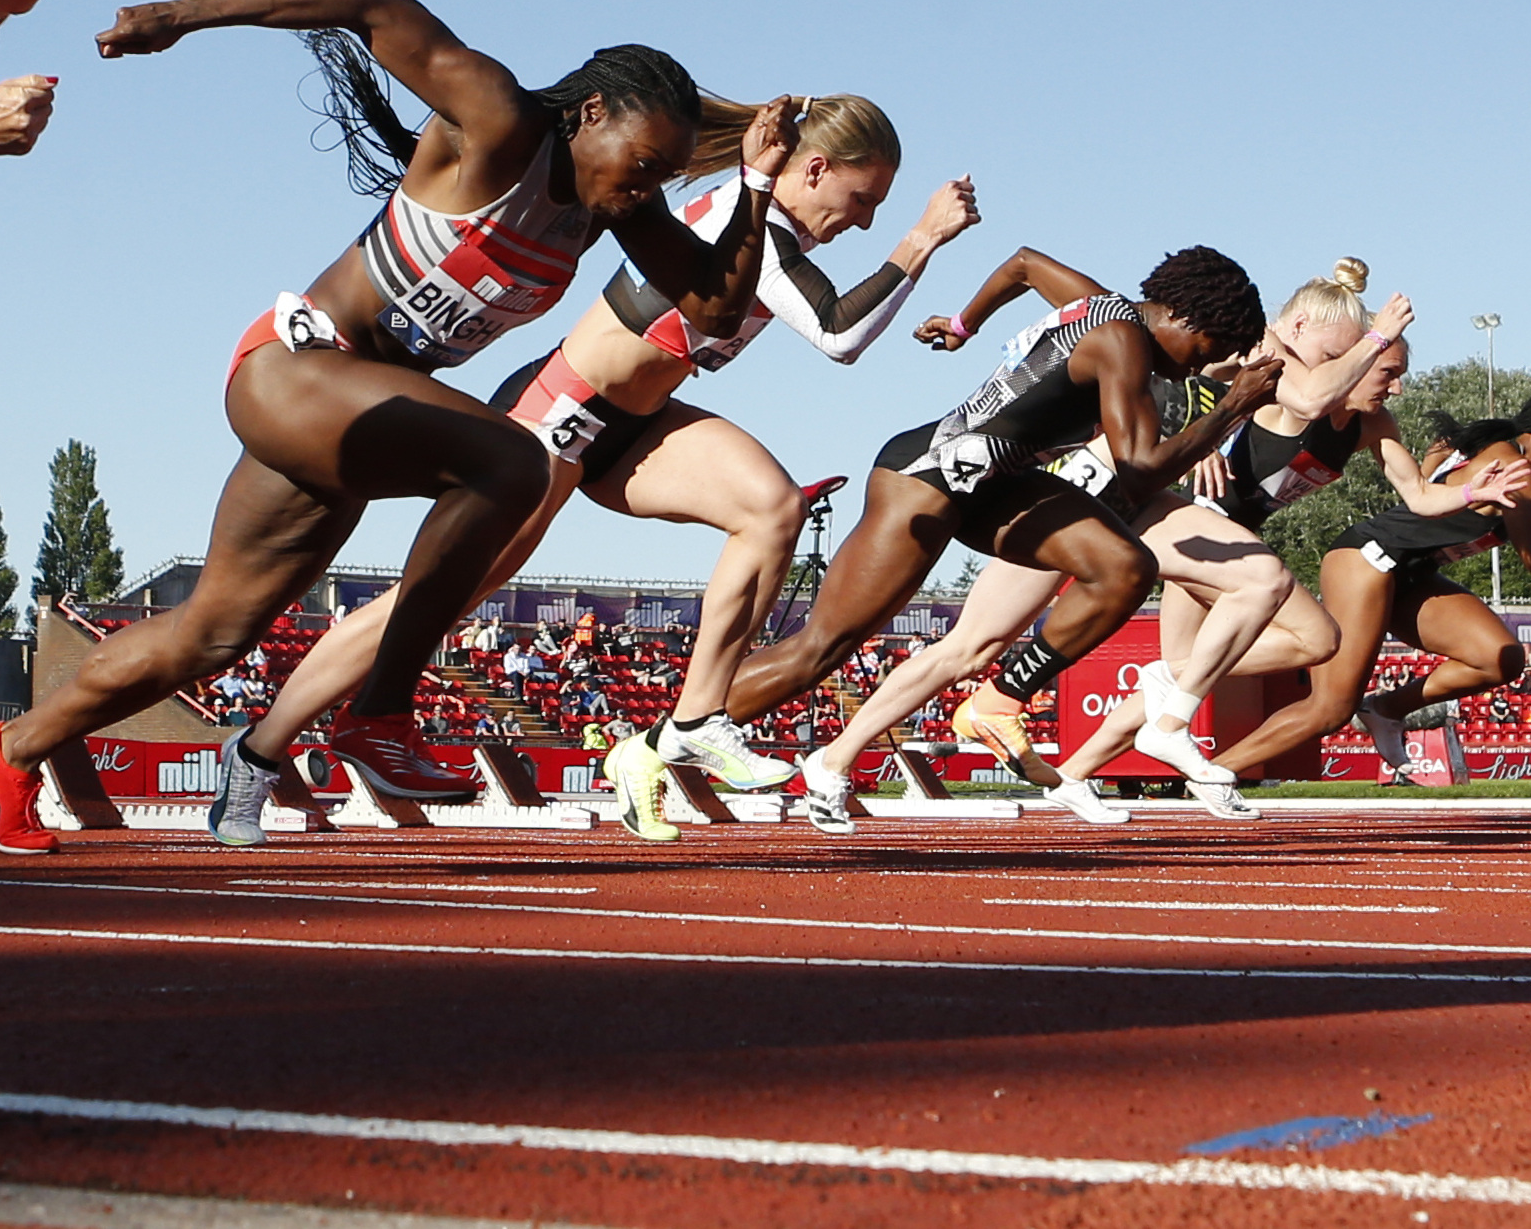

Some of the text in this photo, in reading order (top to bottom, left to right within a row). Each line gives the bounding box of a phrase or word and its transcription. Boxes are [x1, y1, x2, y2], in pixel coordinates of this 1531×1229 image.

[288, 309, 315, 346] 6
[552, 414, 589, 450] 5
[892, 609, 949, 634] müller
[158, 749, 221, 792] müll
[1382, 759, 1446, 775] OEGA
